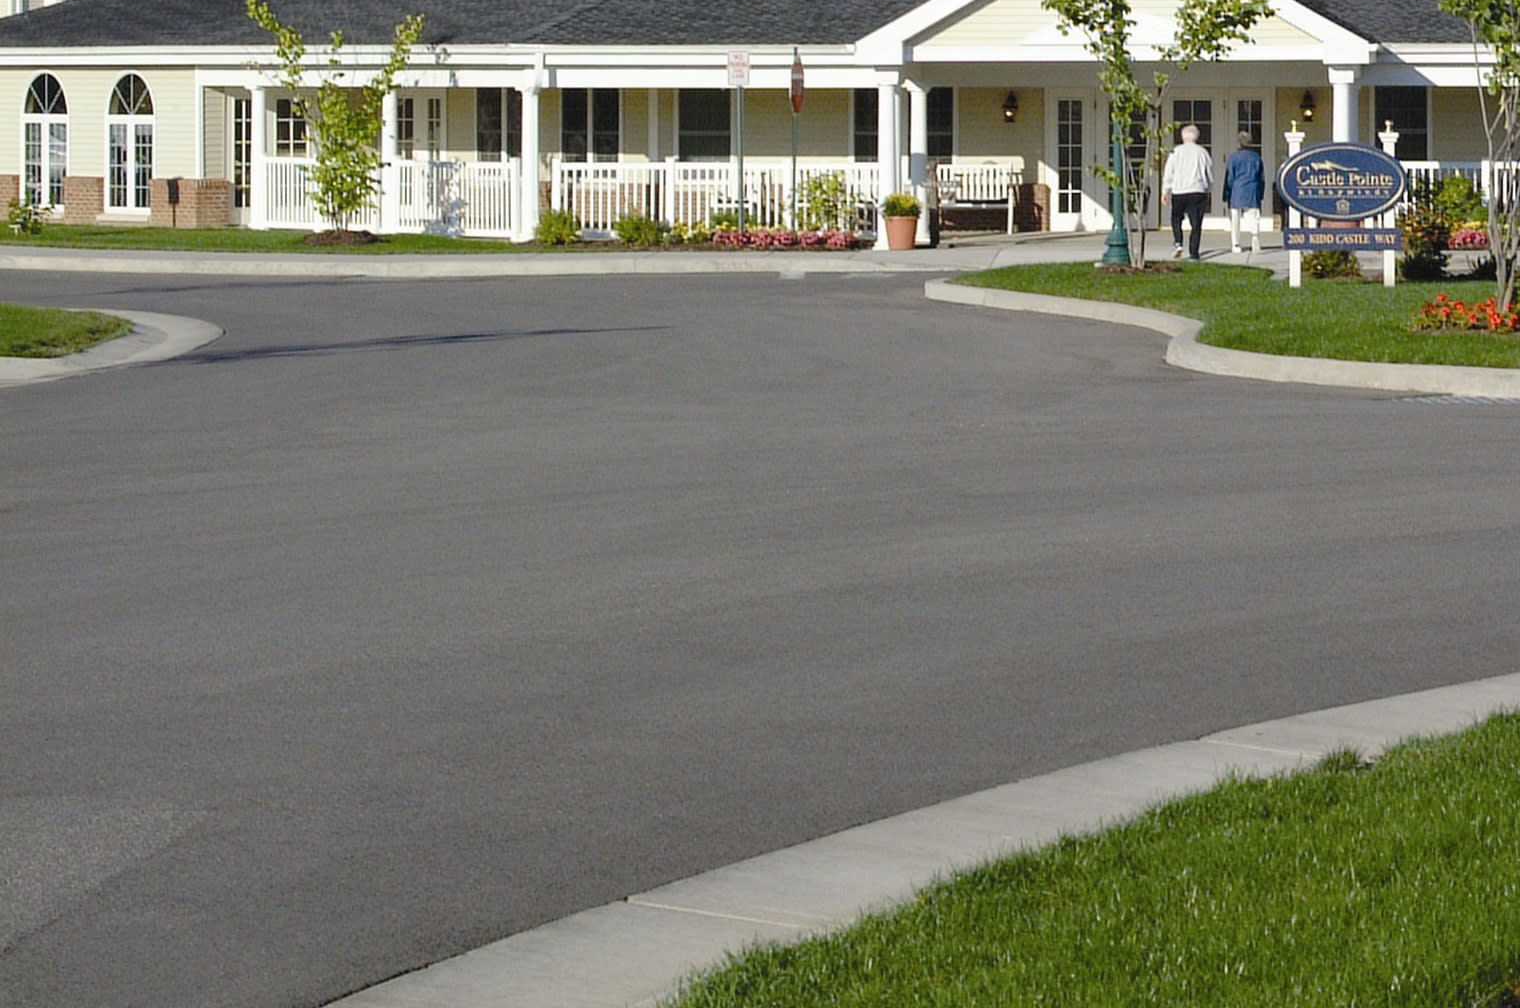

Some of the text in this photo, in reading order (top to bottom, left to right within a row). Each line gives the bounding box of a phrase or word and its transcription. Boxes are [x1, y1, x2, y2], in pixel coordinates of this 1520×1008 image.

[1348, 171, 1393, 186] Pointe
[1335, 233, 1370, 245] CASTLE
[1375, 233, 1396, 245] WAY
